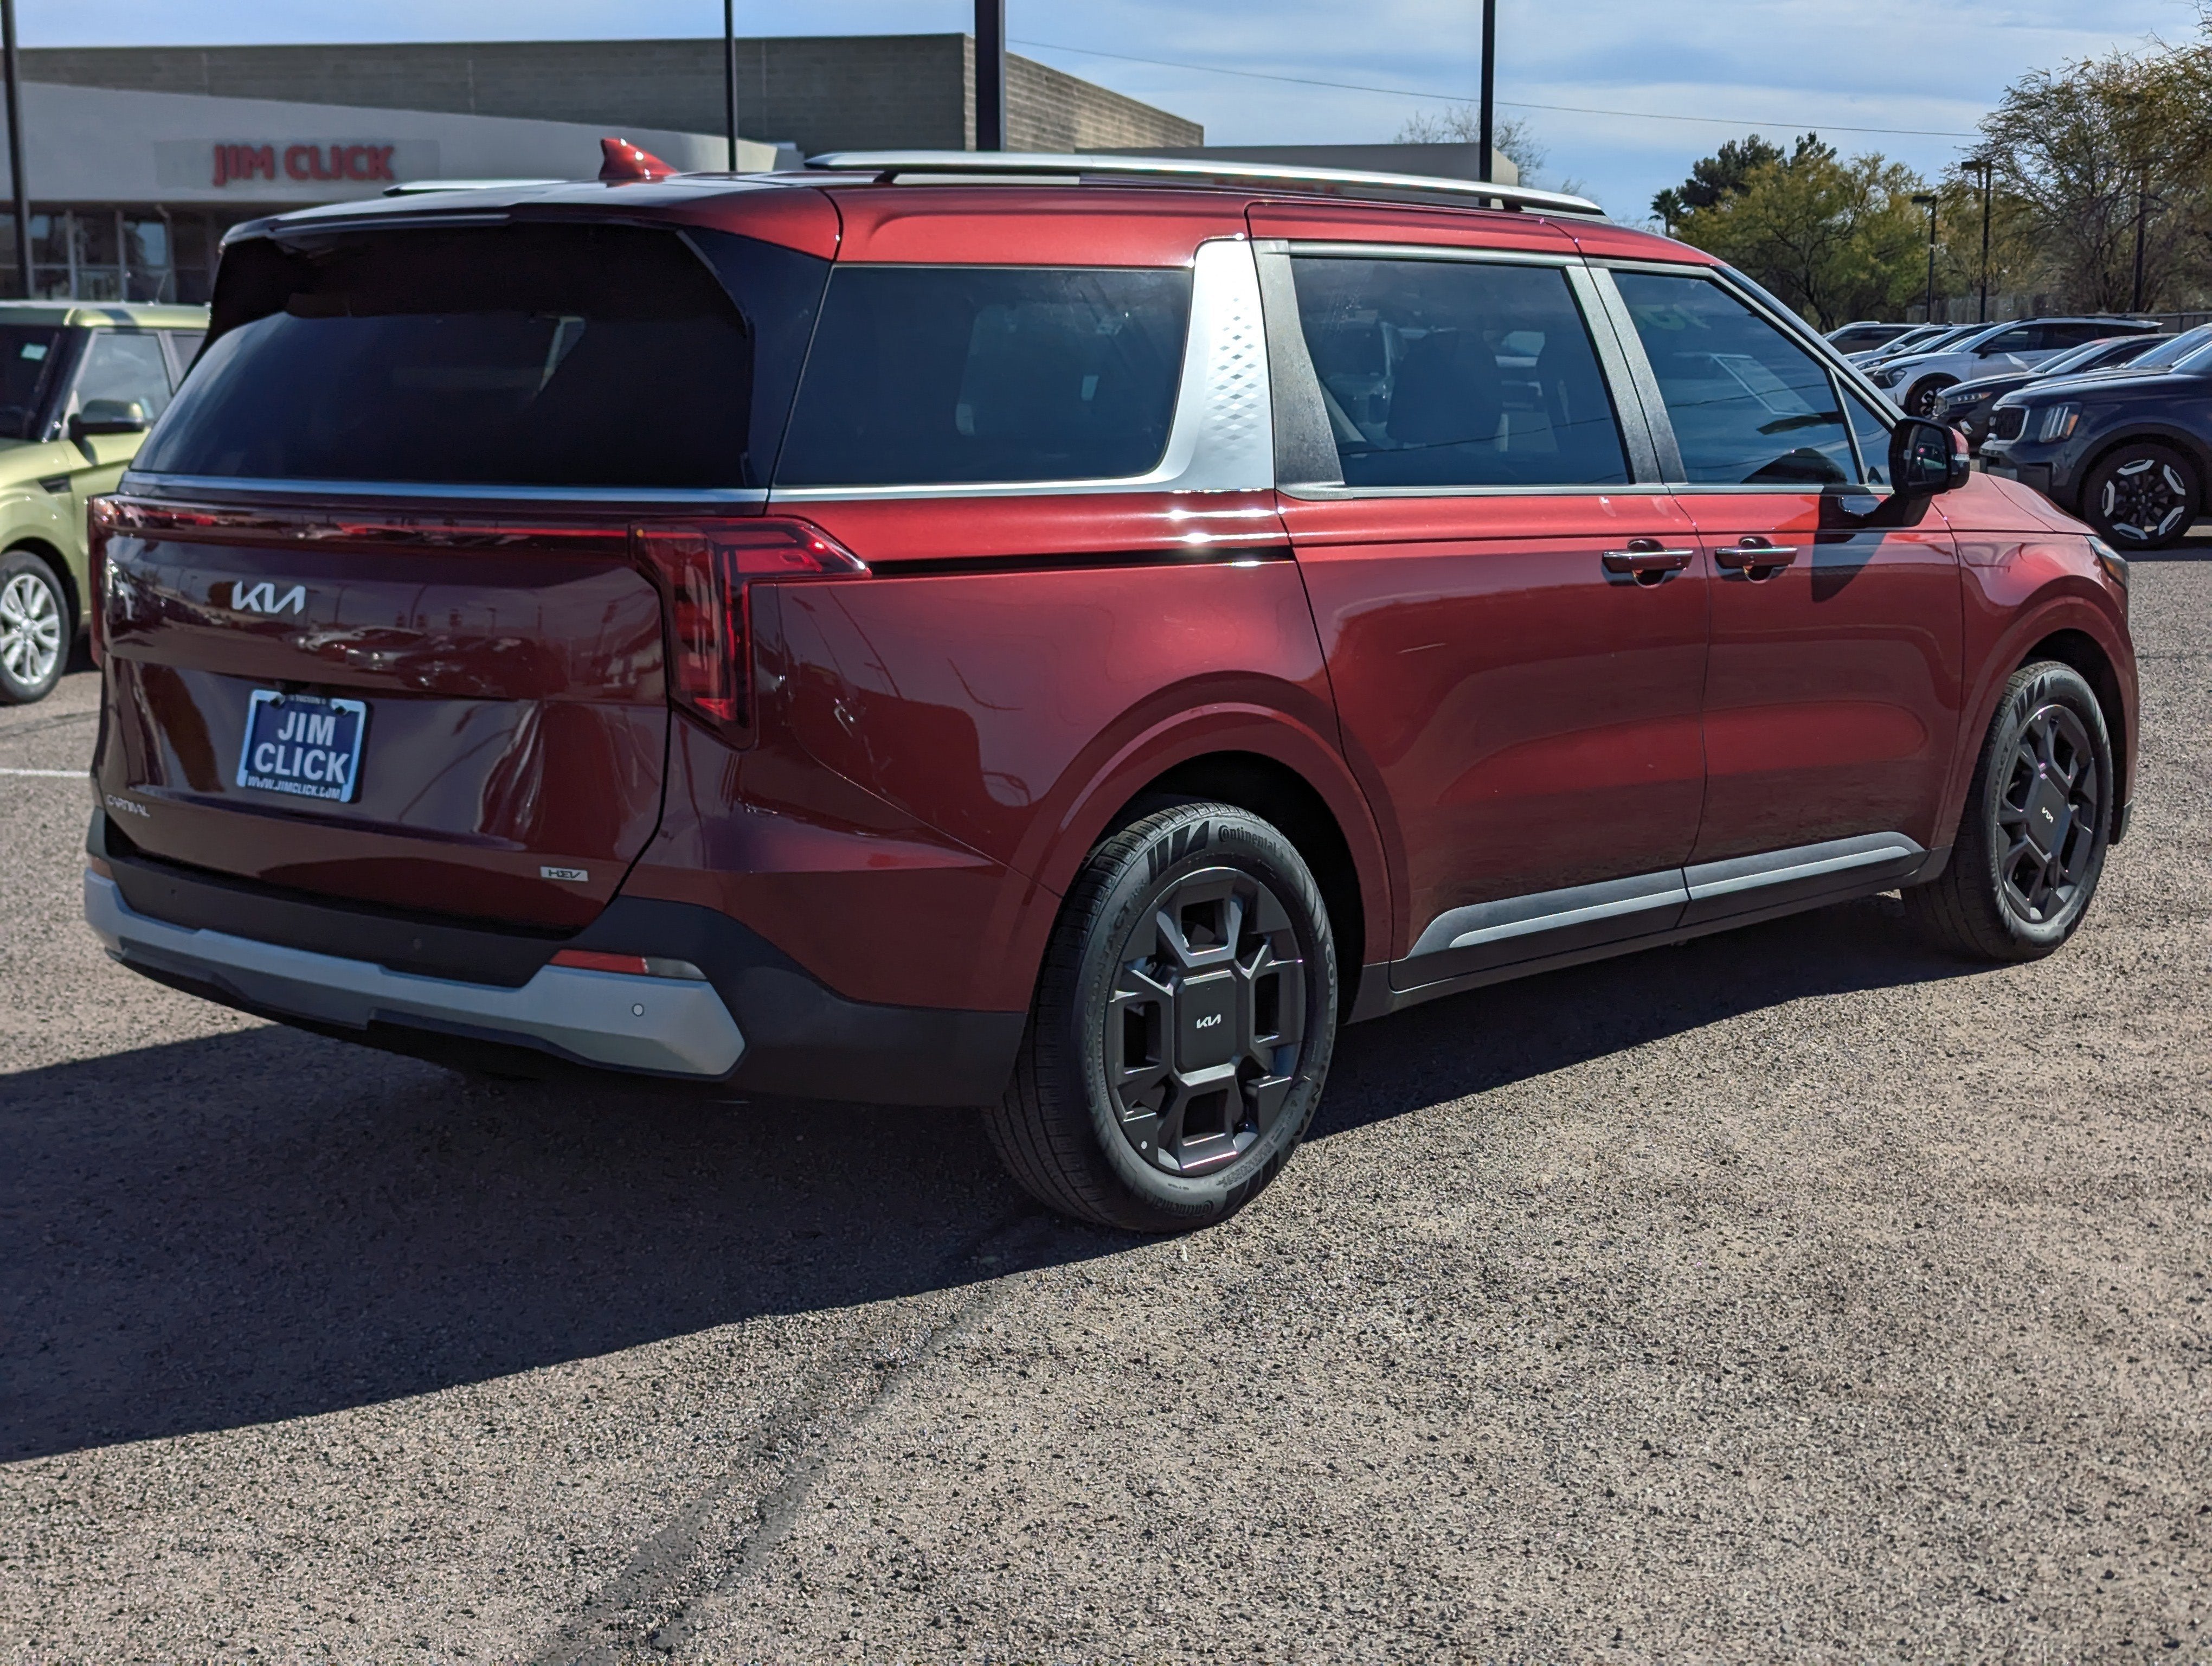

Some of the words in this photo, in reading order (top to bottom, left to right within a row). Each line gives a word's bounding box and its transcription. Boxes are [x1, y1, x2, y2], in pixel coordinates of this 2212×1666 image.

[213, 145, 275, 187] JIM
[285, 145, 394, 181] CLICK
[232, 581, 306, 615] KIA
[278, 711, 336, 746] JIM
[254, 742, 350, 784] CLICK
[1218, 824, 1277, 856] Continental
[548, 869, 581, 879] HEV
[1196, 1014, 1221, 1029] KIA
